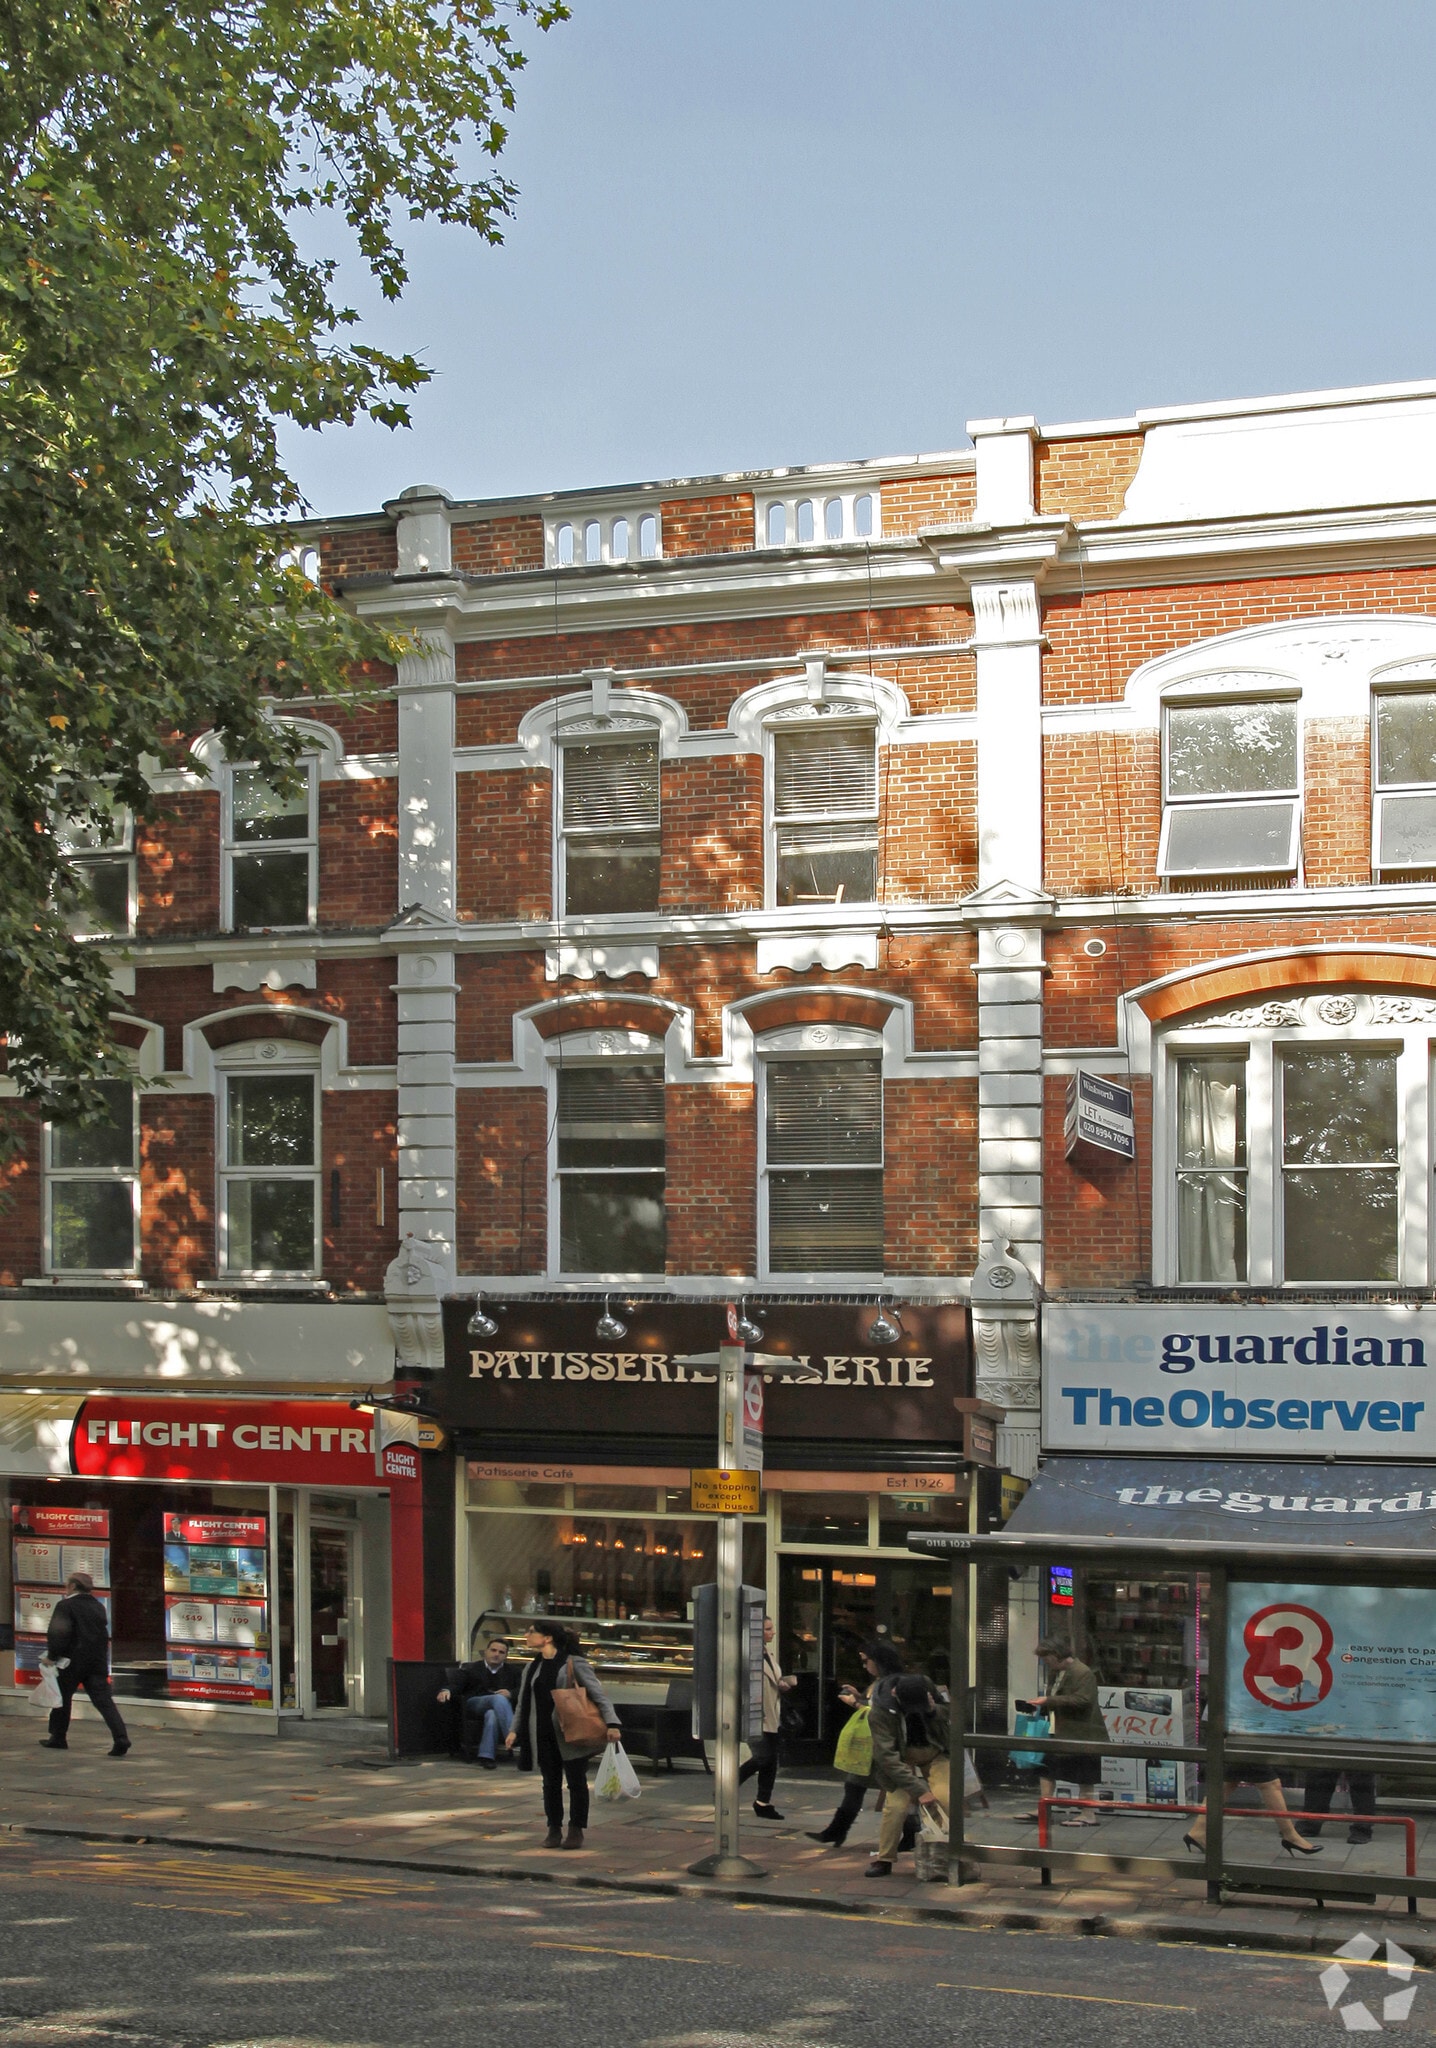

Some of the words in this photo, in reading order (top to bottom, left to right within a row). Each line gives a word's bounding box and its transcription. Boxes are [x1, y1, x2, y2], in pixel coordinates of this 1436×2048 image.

[1083, 1080, 1114, 1100] Winkworth
[1084, 1104, 1098, 1120] LET
[1084, 1121, 1095, 1134] 020
[1096, 1126, 1112, 1140] 8994
[1159, 1326, 1427, 1374] guardian
[87, 1420, 225, 1448] FLIGHT
[419, 1431, 435, 1440] ADT
[386, 1451, 415, 1466] FLIGHT
[386, 1463, 417, 1478] CENTRE
[477, 1466, 539, 1478] Patisserie
[543, 1468, 575, 1479] Café
[713, 1483, 757, 1492] stopping
[886, 1477, 909, 1488] Est.
[915, 1478, 944, 1489] 1926
[708, 1493, 742, 1501] except
[696, 1501, 720, 1509] local
[724, 1502, 754, 1510] buses
[36, 1513, 68, 1521] FLIGHT
[69, 1514, 103, 1523] CENTRE
[188, 1520, 222, 1529] FLIGHT
[223, 1522, 260, 1530] CENTRE
[926, 1539, 947, 1548] 0118
[949, 1540, 971, 1549] 1023
[1377, 1646, 1404, 1654] ways
[1249, 1608, 1328, 1707] 3
[1341, 1653, 1406, 1665] Congestion
[183, 1687, 255, 1696] www.flightcentre.co.uk
